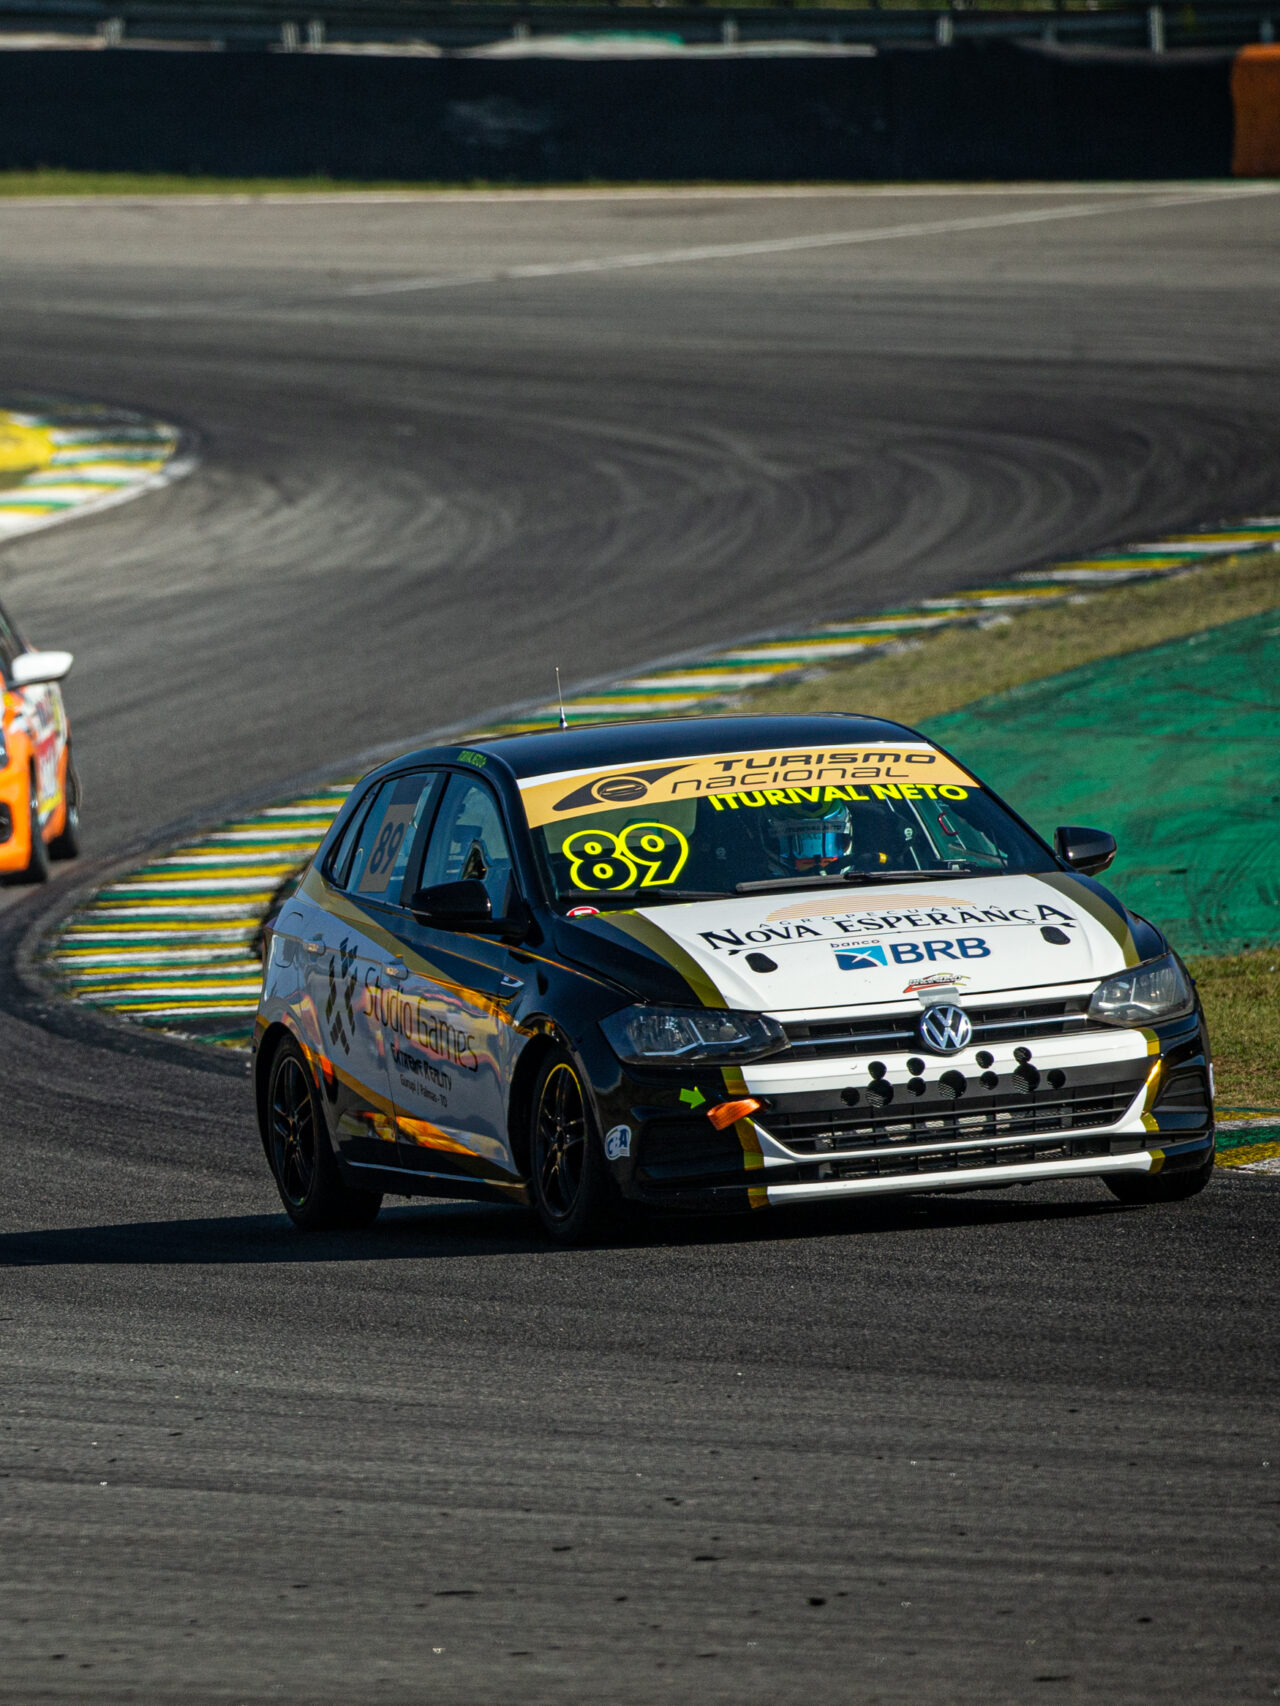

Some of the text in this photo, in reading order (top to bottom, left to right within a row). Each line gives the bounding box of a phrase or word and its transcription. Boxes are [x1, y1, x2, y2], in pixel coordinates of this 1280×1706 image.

[713, 752, 937, 772] TURISMO
[671, 766, 910, 795] nacional
[707, 783, 969, 812] ITURIVAL NETO
[371, 821, 405, 875] 89
[562, 822, 690, 891] 89
[833, 903, 1077, 934] ESPERANÇA
[830, 938, 881, 949] banco
[888, 936, 992, 965] BRB
[362, 966, 479, 1073] Studio Games
